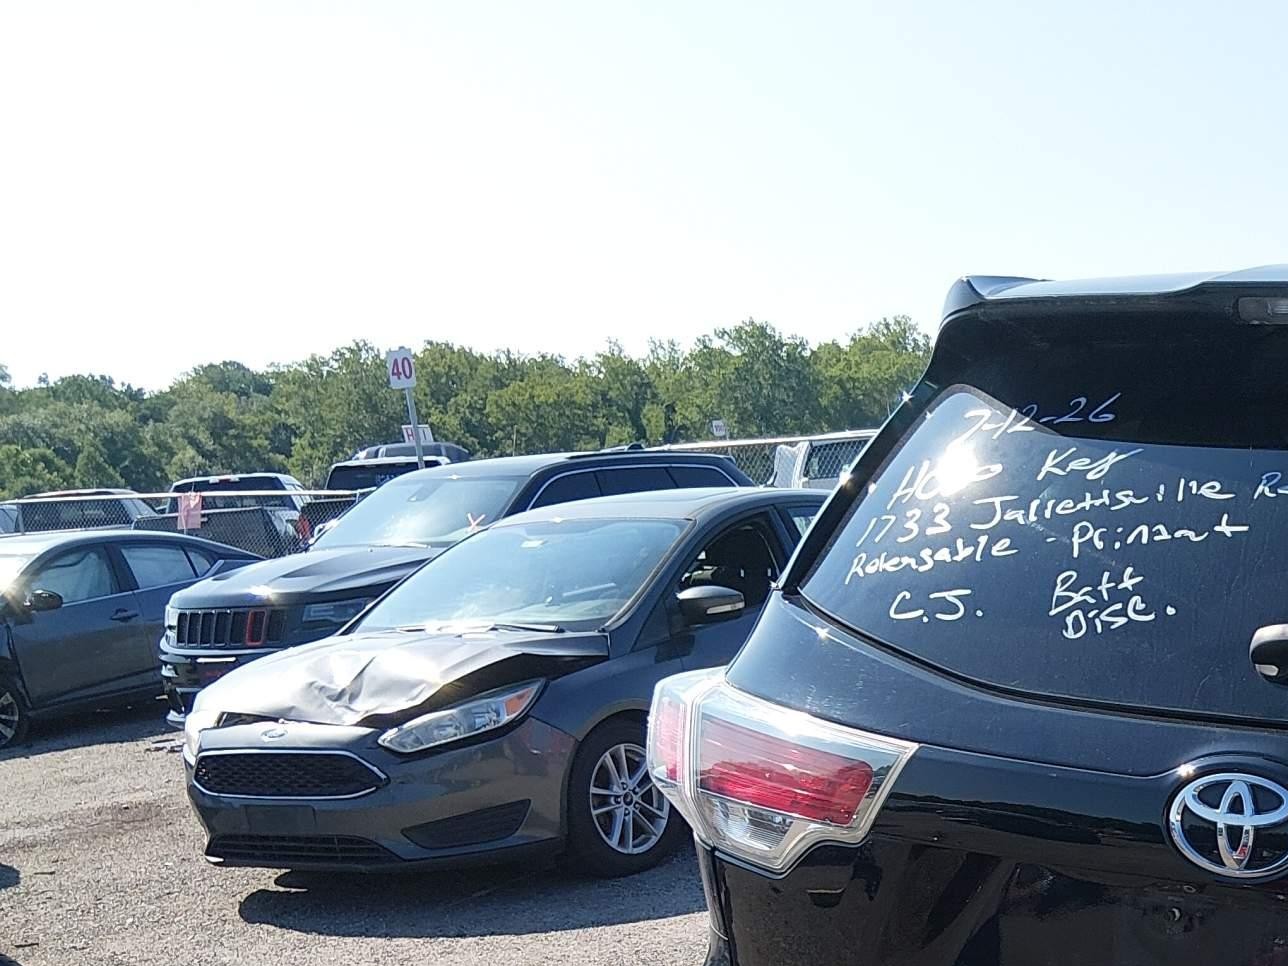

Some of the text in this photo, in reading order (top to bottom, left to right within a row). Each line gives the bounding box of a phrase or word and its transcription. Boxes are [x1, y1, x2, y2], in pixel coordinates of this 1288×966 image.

[391, 356, 414, 380] 40
[1036, 446, 1145, 481] Key
[855, 502, 953, 548] 1733
